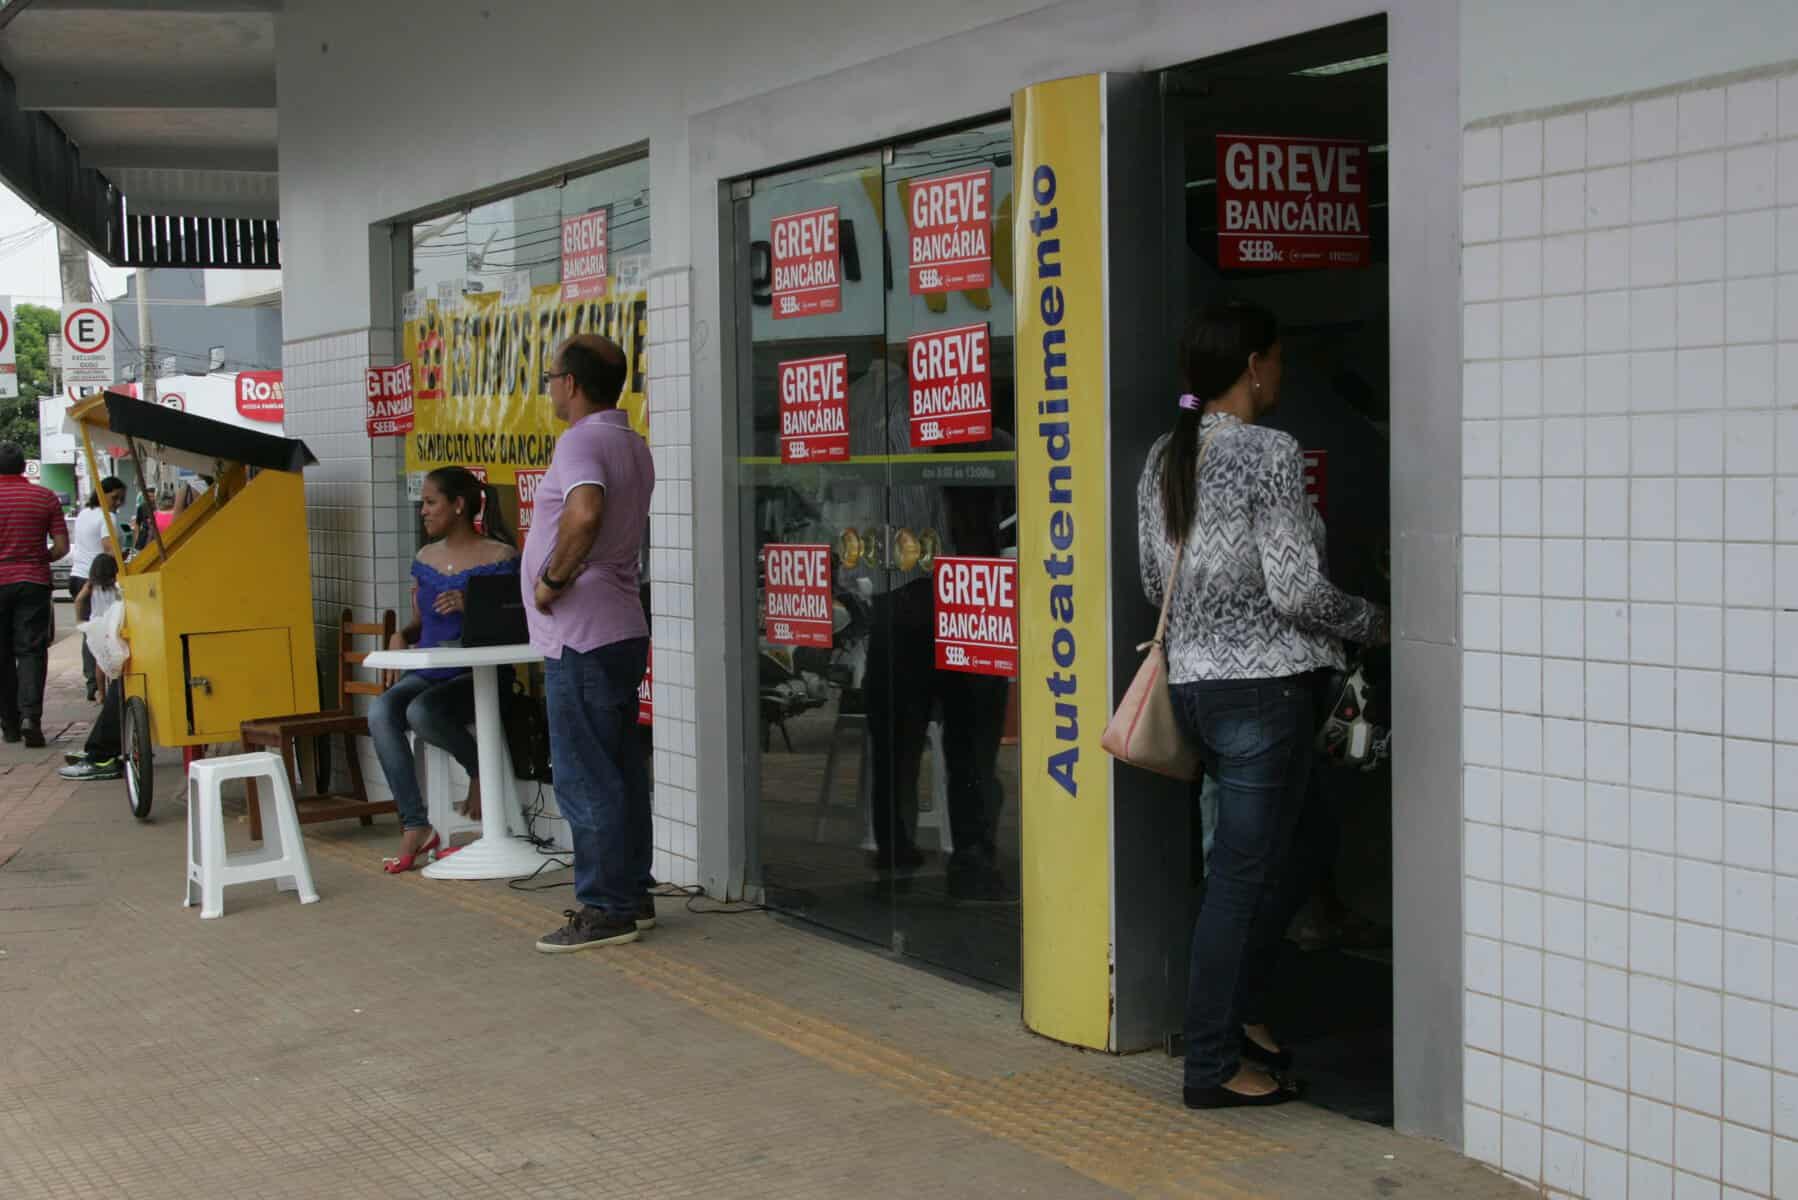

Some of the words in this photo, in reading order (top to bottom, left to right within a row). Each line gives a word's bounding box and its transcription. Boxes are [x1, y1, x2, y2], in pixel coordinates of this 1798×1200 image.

[1225, 142, 1361, 193] GREVE
[912, 178, 987, 229] GREVE
[1225, 193, 1361, 233] BANCÁRIA
[563, 216, 606, 254] GREVE
[774, 213, 836, 260] GREVE
[912, 225, 987, 264] BANCÁRIA
[774, 256, 837, 291] BANCÁRIA
[78, 319, 95, 343] E
[911, 331, 986, 382] GREVE
[782, 361, 845, 405] GREVE
[912, 378, 987, 415] BANCÁRIA
[783, 400, 845, 435] BANCÁRIA
[416, 432, 473, 463] SINDICATO
[1030, 163, 1078, 799] Autoatendimento
[767, 550, 828, 587] GREVE
[938, 563, 1014, 608] GREVE
[768, 589, 828, 619] BANCÁRIA
[938, 607, 1014, 643] BANCÁRIA
